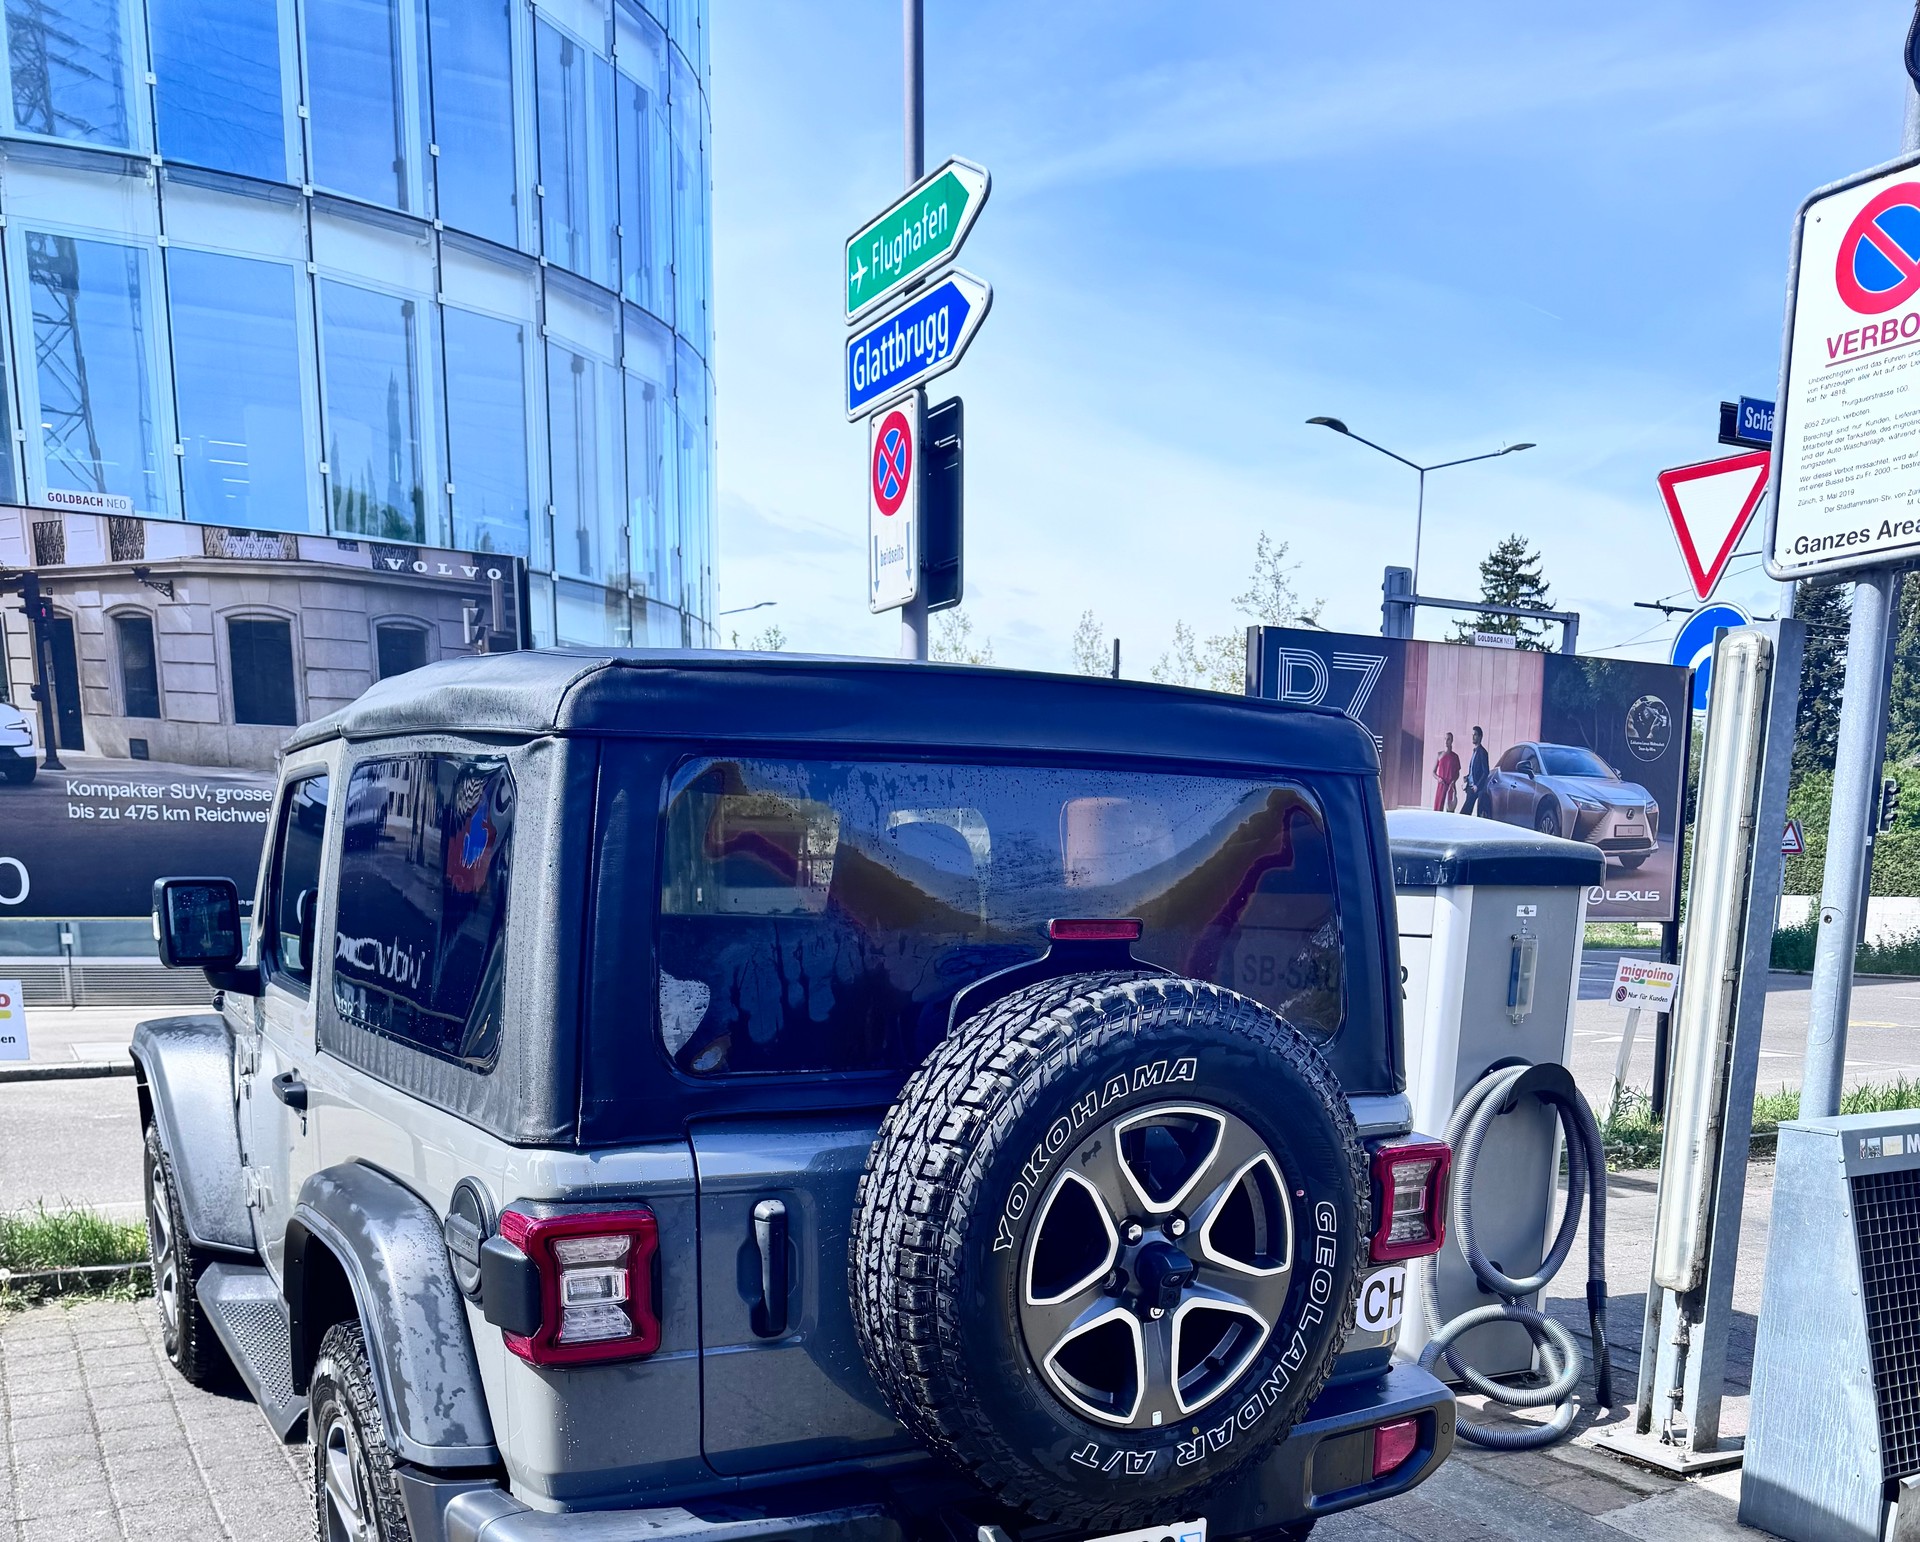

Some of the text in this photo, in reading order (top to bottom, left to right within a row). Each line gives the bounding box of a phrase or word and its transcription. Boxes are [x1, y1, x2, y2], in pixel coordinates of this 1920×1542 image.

[872, 202, 947, 280] Flughafen
[1826, 312, 1920, 360] VERBO
[853, 304, 949, 392] Glattbrugg
[1808, 368, 1853, 384] Unberechtigten
[1856, 364, 1868, 372] wird
[1820, 377, 1855, 390] Fahrzeugen
[1872, 369, 1882, 377] Art
[1885, 366, 1895, 374] auf
[1897, 362, 1908, 370] der
[1841, 390, 1894, 406] Thurgauerstrasse
[1801, 453, 1813, 461] und
[1888, 428, 1916, 440] während
[1802, 440, 1833, 451] Mitarbeiter
[1803, 430, 1833, 442] Berechtigt
[1813, 470, 1832, 480] dieses
[1834, 466, 1854, 475] Verbot
[1892, 454, 1907, 462] wird
[1908, 450, 1919, 458] auf
[1809, 482, 1824, 490] einer
[1825, 478, 1844, 486] Busse
[1839, 489, 1855, 498] 2019
[47, 492, 127, 510] GOLDBACH NEO
[1824, 506, 1835, 514] Der
[1794, 528, 1870, 555] Ganzes
[384, 558, 502, 580] VOLVO
[1478, 635, 1503, 644] GOLDBACH
[66, 780, 273, 804] Kompakter SUV, grosse
[68, 803, 270, 823] bis zu 475 km Reichwei
[1606, 890, 1660, 901] LEXUS
[1621, 964, 1674, 981] migrolino
[1649, 994, 1668, 1002] Kunden
[993, 1058, 1198, 1252] YOKOHAMA
[1364, 1272, 1405, 1324] CH
[1176, 1201, 1336, 1467] GEOLANDAR
[1070, 1442, 1156, 1475] A/T
